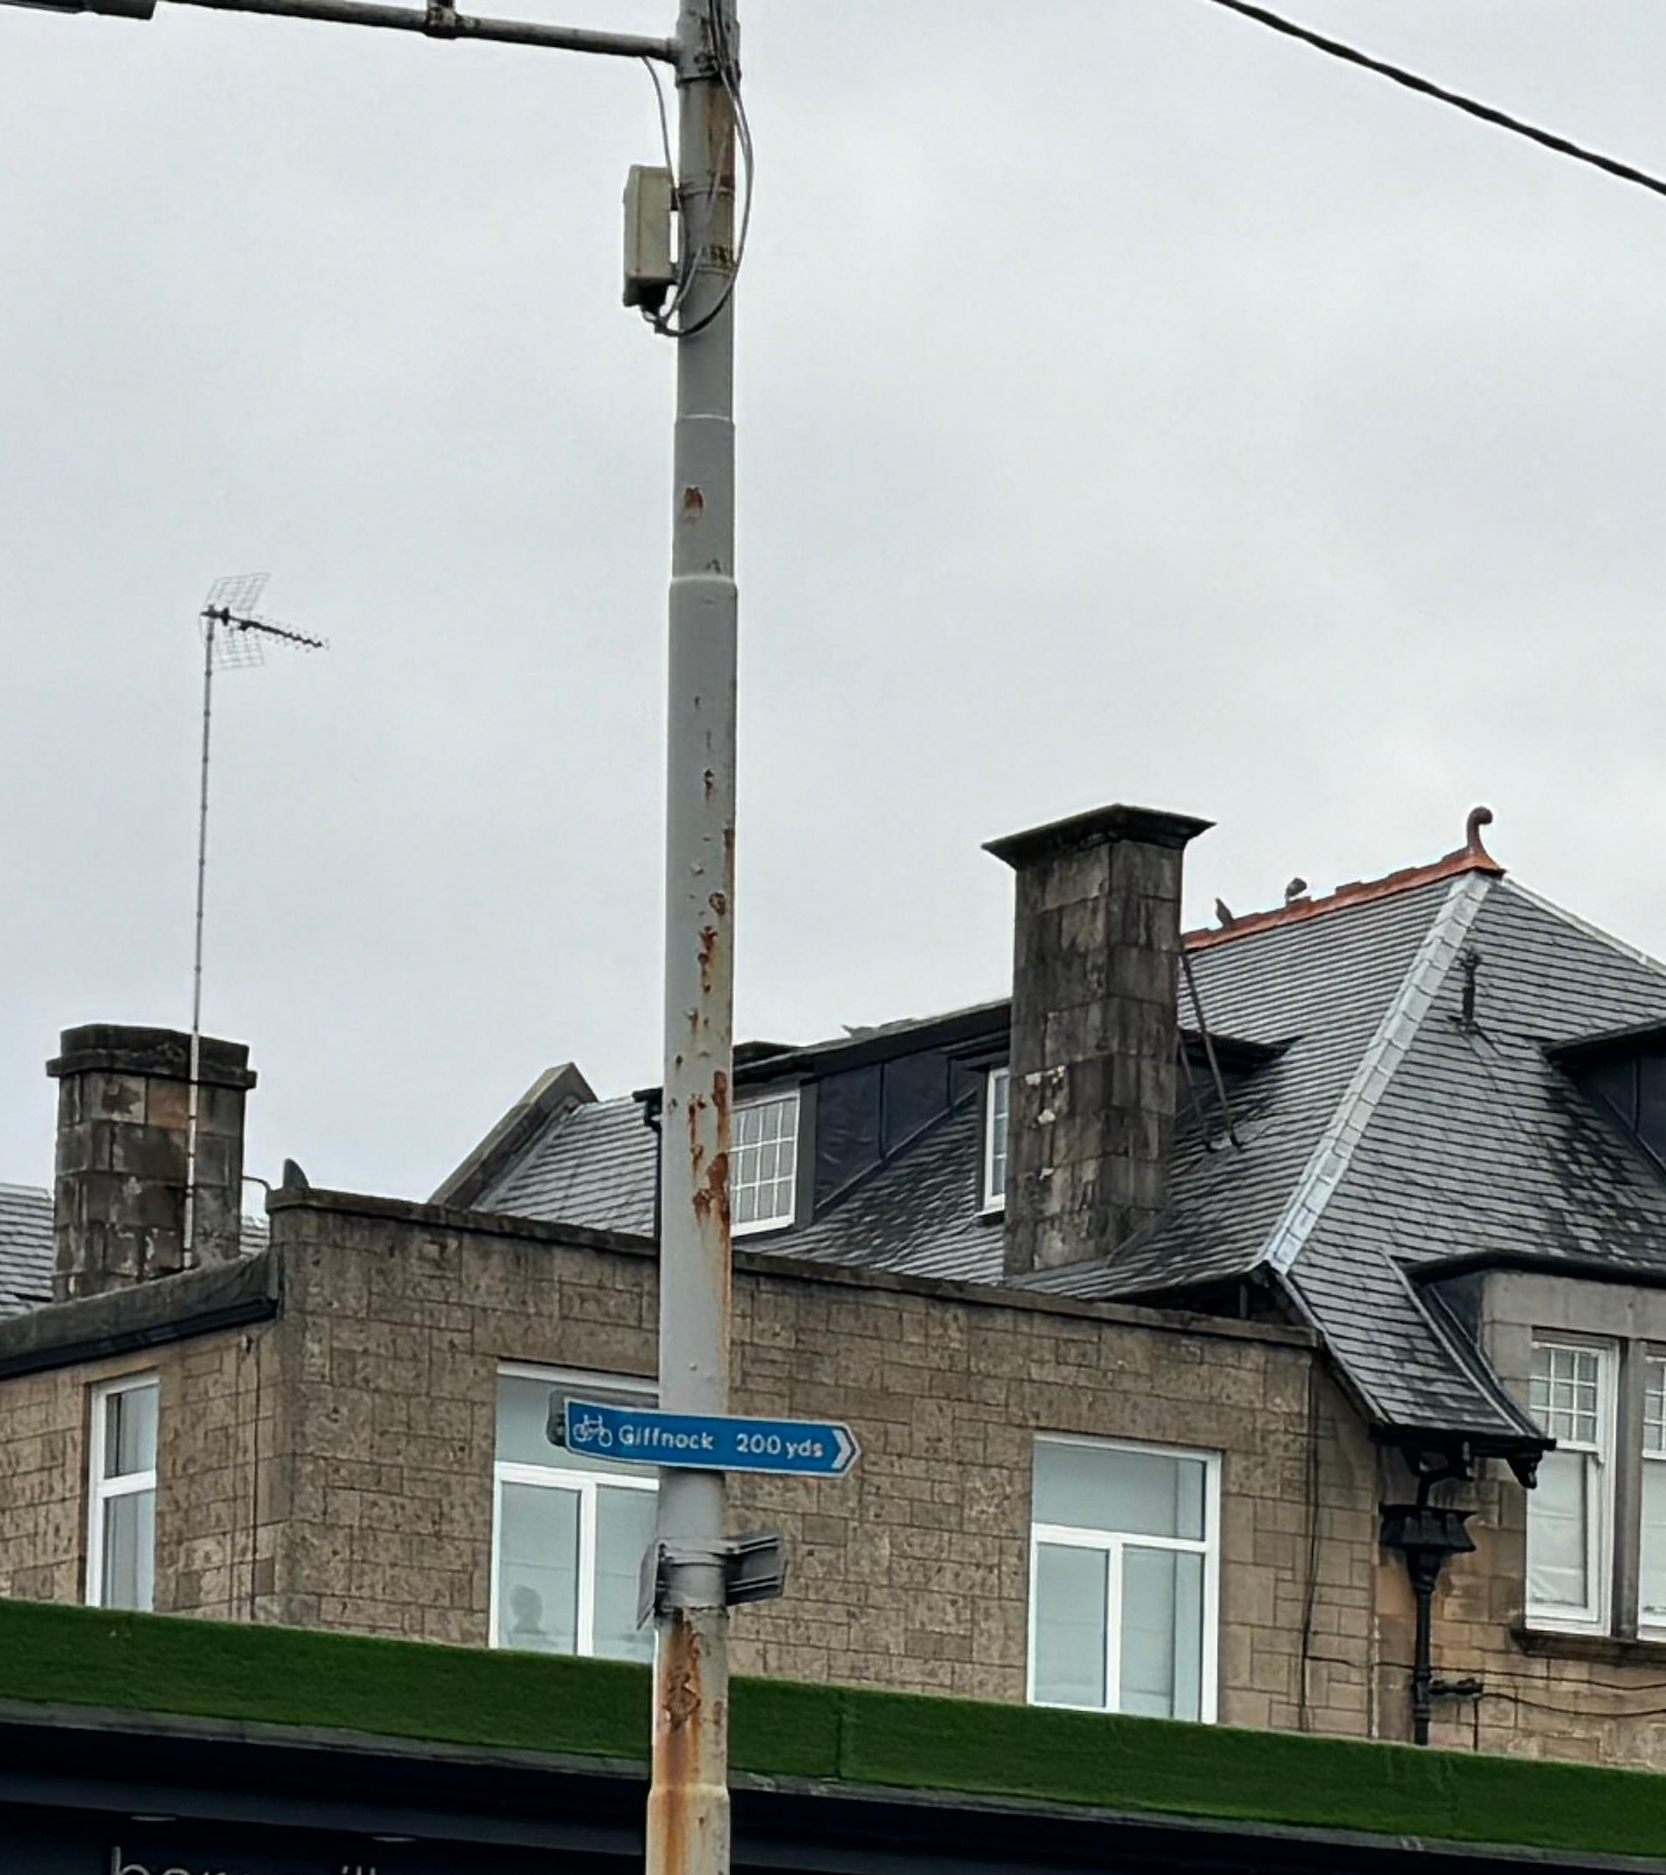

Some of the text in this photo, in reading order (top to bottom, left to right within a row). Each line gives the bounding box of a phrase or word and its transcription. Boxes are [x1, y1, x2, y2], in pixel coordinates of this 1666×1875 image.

[617, 1425, 824, 1460] Giffnock 200 yds
